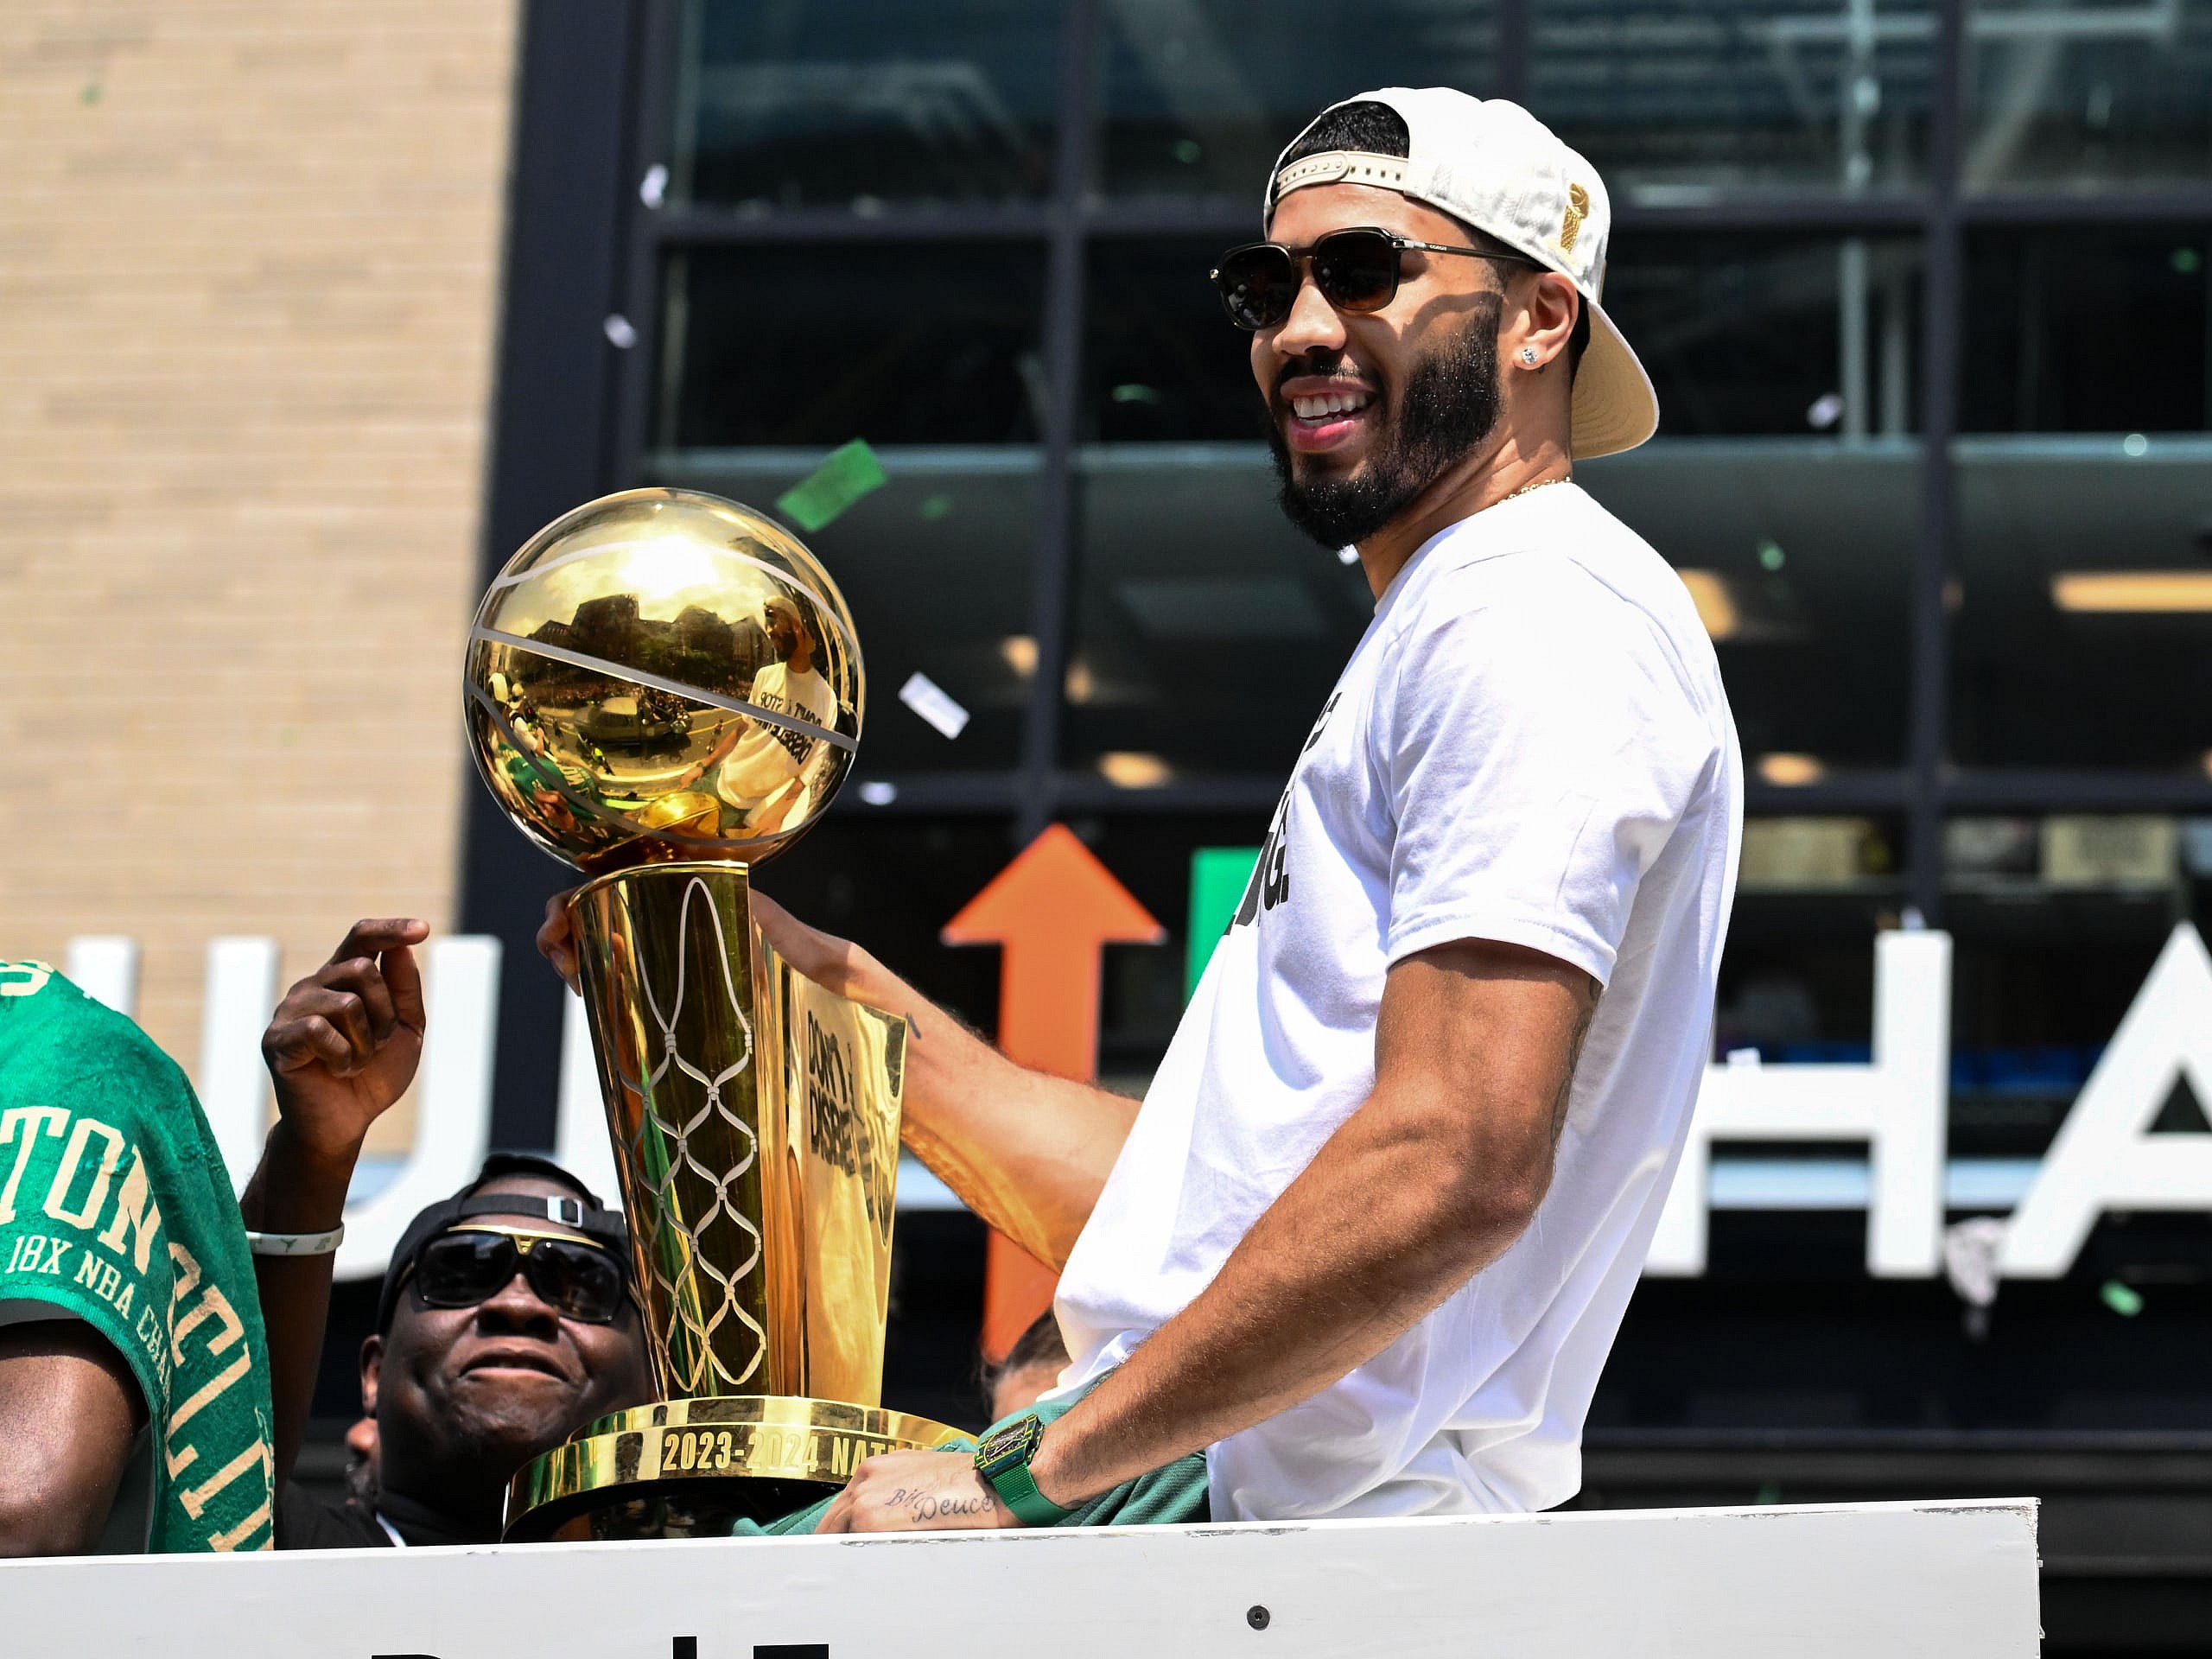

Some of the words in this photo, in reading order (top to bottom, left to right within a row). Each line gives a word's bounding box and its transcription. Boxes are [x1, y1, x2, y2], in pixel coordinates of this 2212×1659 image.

[4, 1235, 73, 1274] 18X
[73, 1249, 136, 1320] NBA
[662, 1430, 819, 1472] 2023-2024
[912, 1496, 995, 1523] Deuce
